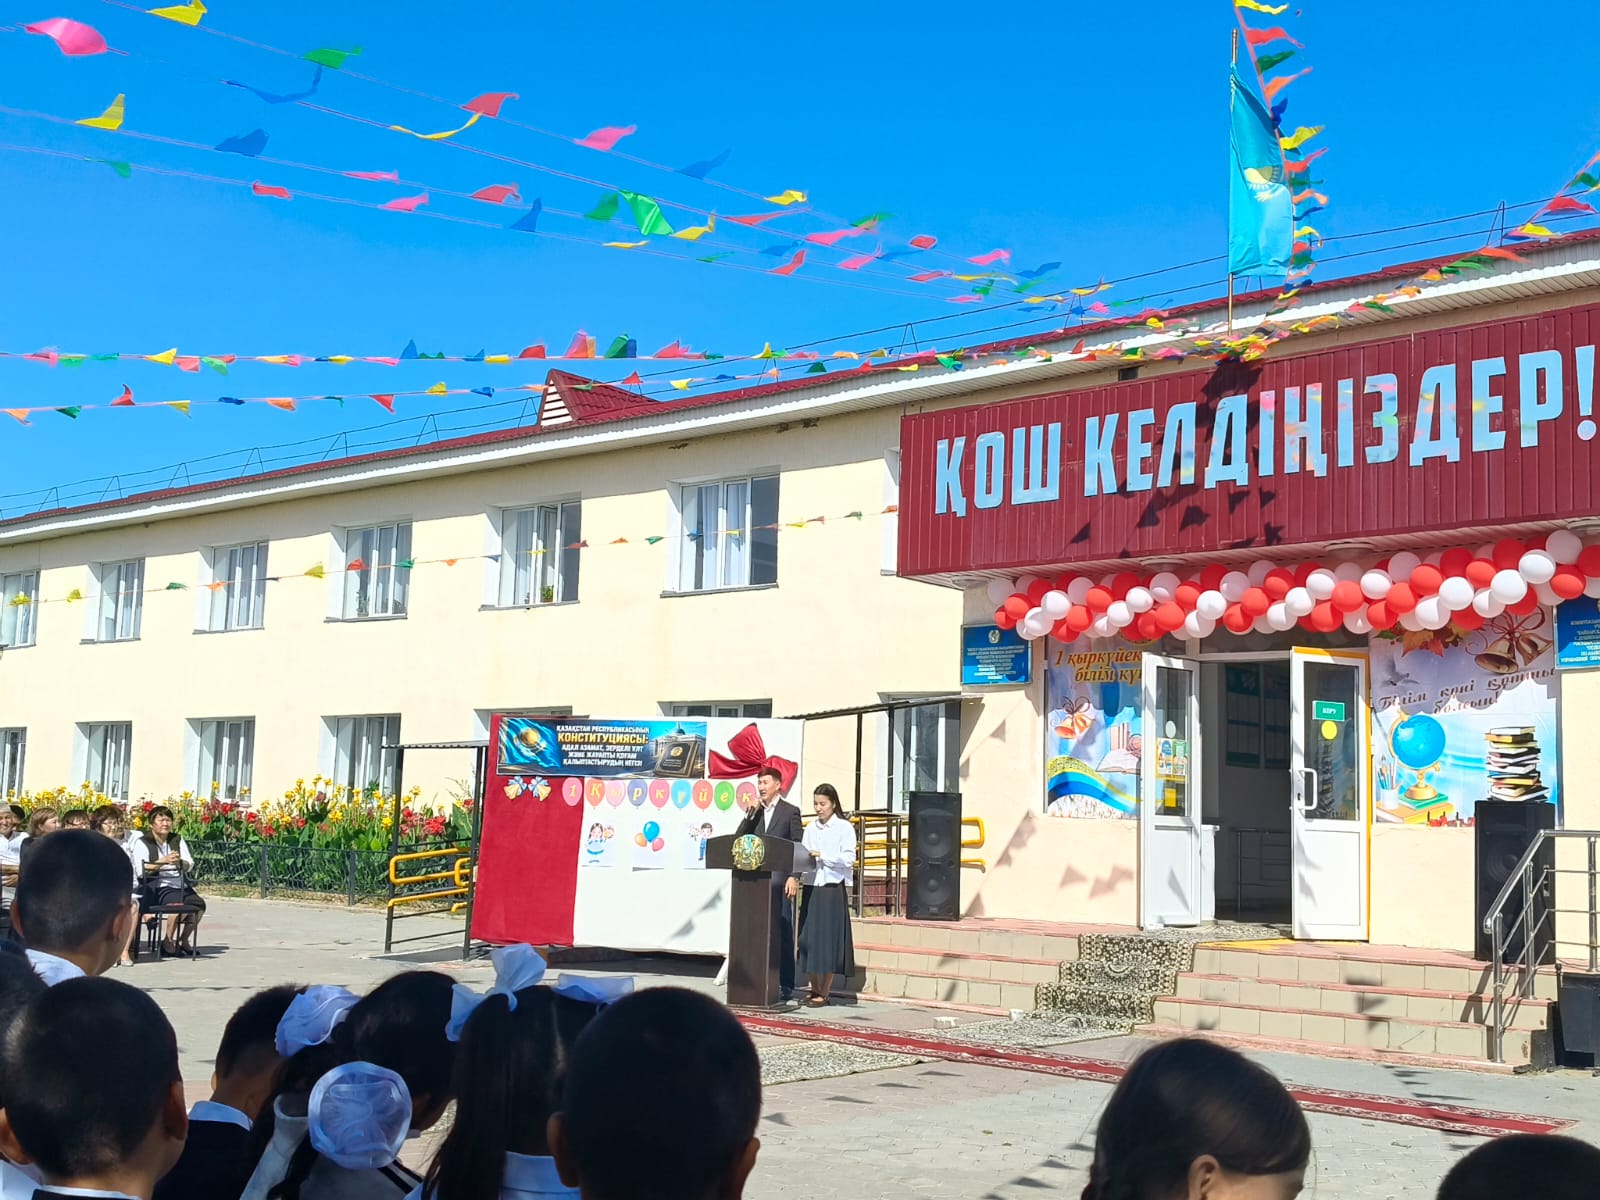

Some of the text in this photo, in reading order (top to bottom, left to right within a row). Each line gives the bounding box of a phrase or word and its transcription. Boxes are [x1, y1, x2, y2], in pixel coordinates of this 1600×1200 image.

[934, 344, 1597, 518] ҚОШ КЕЛДІҢІЗДЕР!
[1055, 650, 1064, 666] 1
[1075, 666, 1115, 682] білім
[1379, 691, 1427, 709] Білім
[558, 733, 648, 744] КОНСТИТУЦИЯСЫ:
[569, 784, 577, 797] 1
